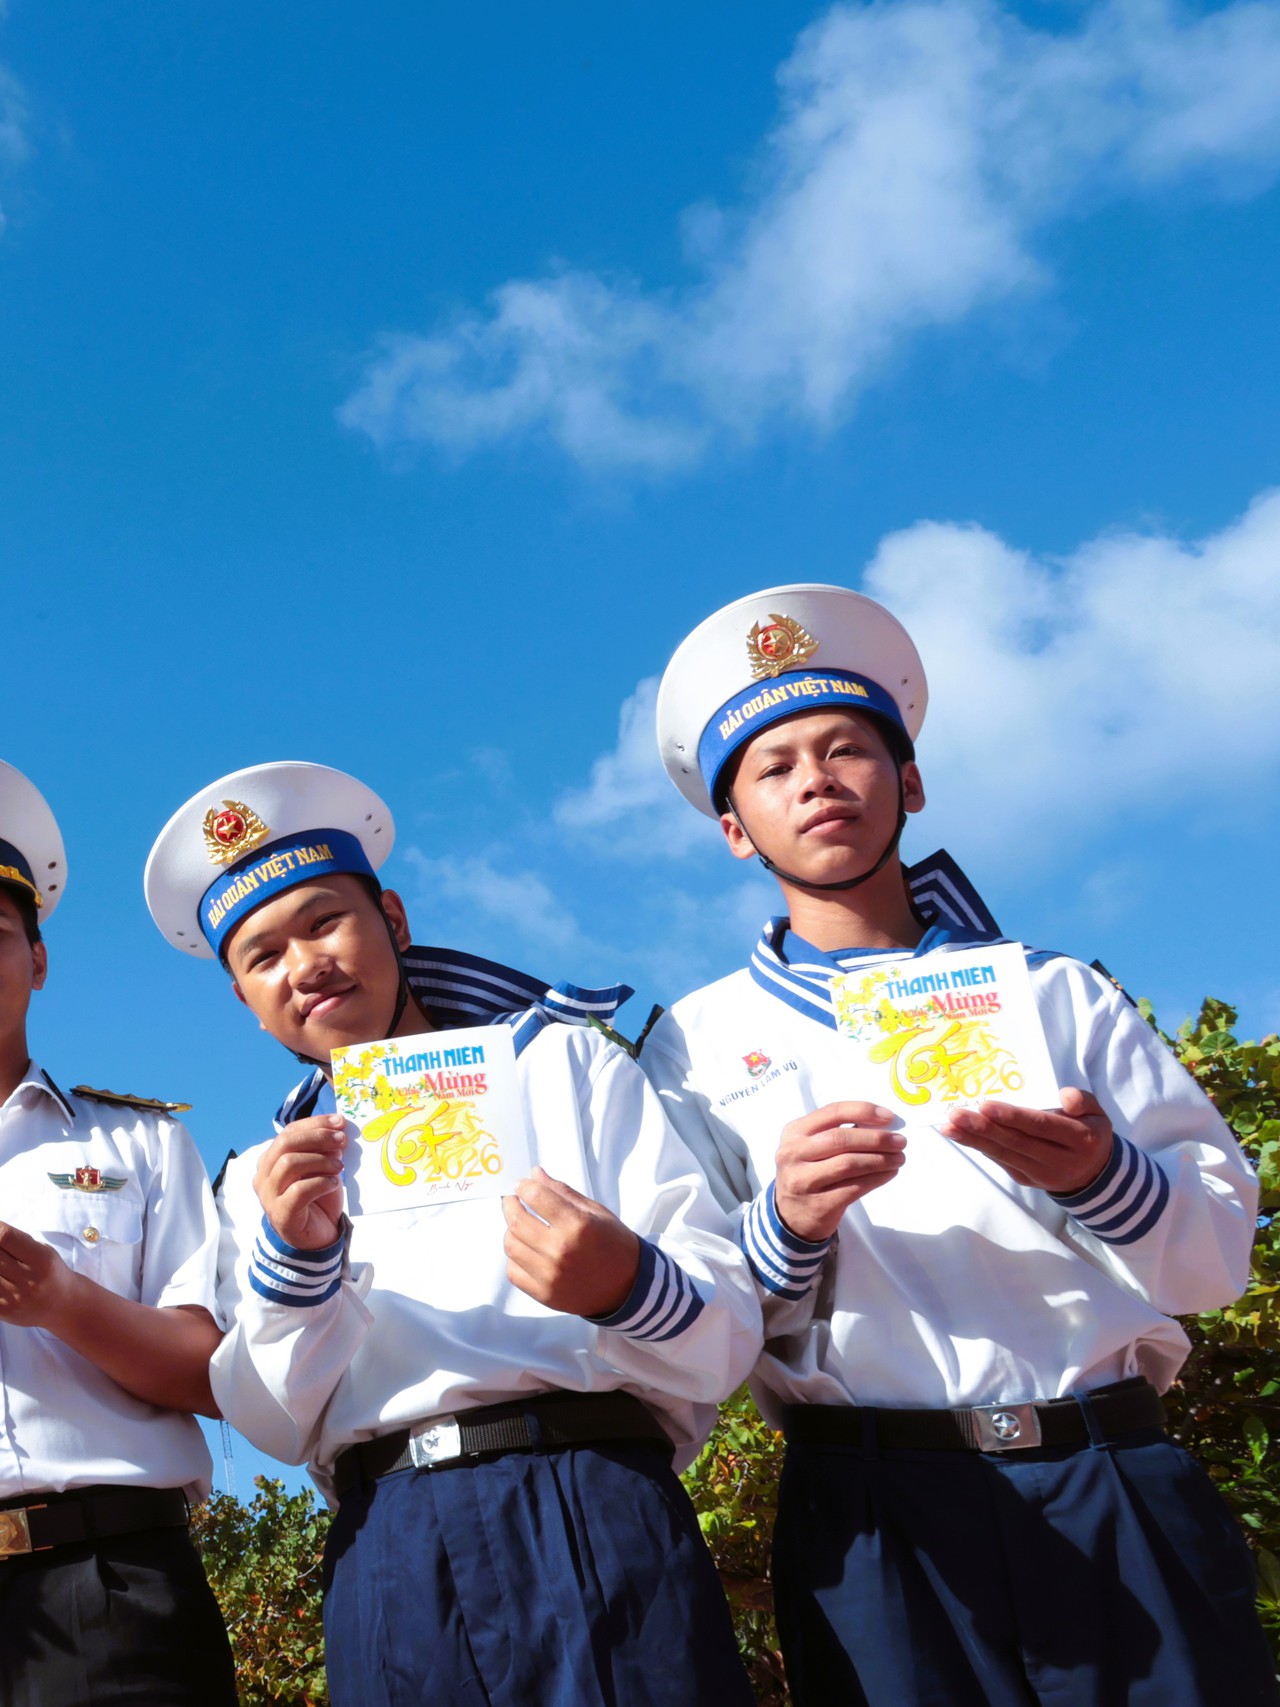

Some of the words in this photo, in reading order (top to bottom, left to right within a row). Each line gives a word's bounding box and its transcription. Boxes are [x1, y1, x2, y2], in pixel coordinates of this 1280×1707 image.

[719, 709, 745, 741] HẢI
[742, 687, 790, 720] QUÂN
[786, 677, 828, 698] VIỆT
[832, 679, 869, 698] NAM
[208, 899, 227, 930] HẢI
[223, 872, 260, 908] QUÂN
[254, 852, 295, 883] VIỆT
[296, 844, 334, 868] NAM
[884, 972, 950, 999] THANH
[931, 992, 1001, 1013] Mừng
[382, 1050, 442, 1076] THANH
[424, 1070, 488, 1095] Mừng
[938, 1060, 1024, 1102] 2026
[423, 1143, 503, 1183] 2026
